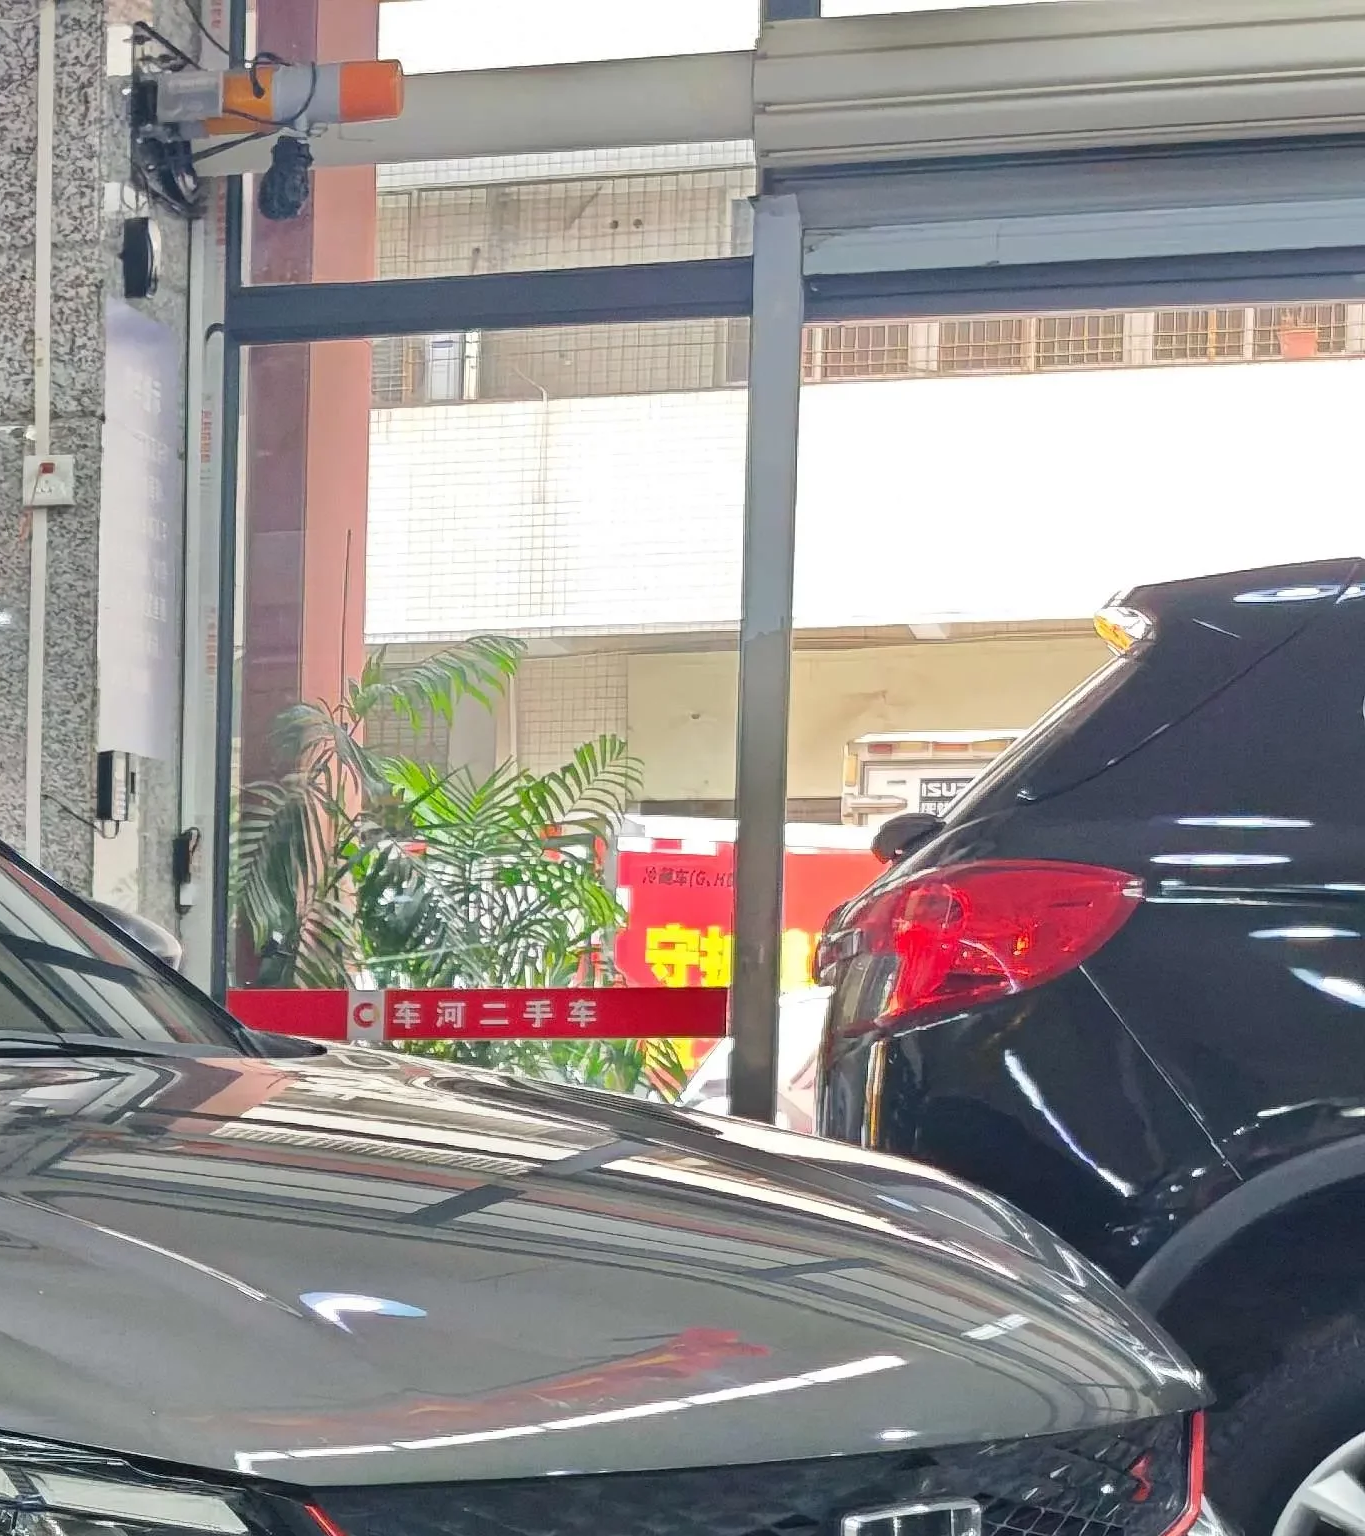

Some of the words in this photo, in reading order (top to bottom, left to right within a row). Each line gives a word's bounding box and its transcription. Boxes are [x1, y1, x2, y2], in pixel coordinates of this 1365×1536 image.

[392, 1000, 598, 1029] 车河二手车
